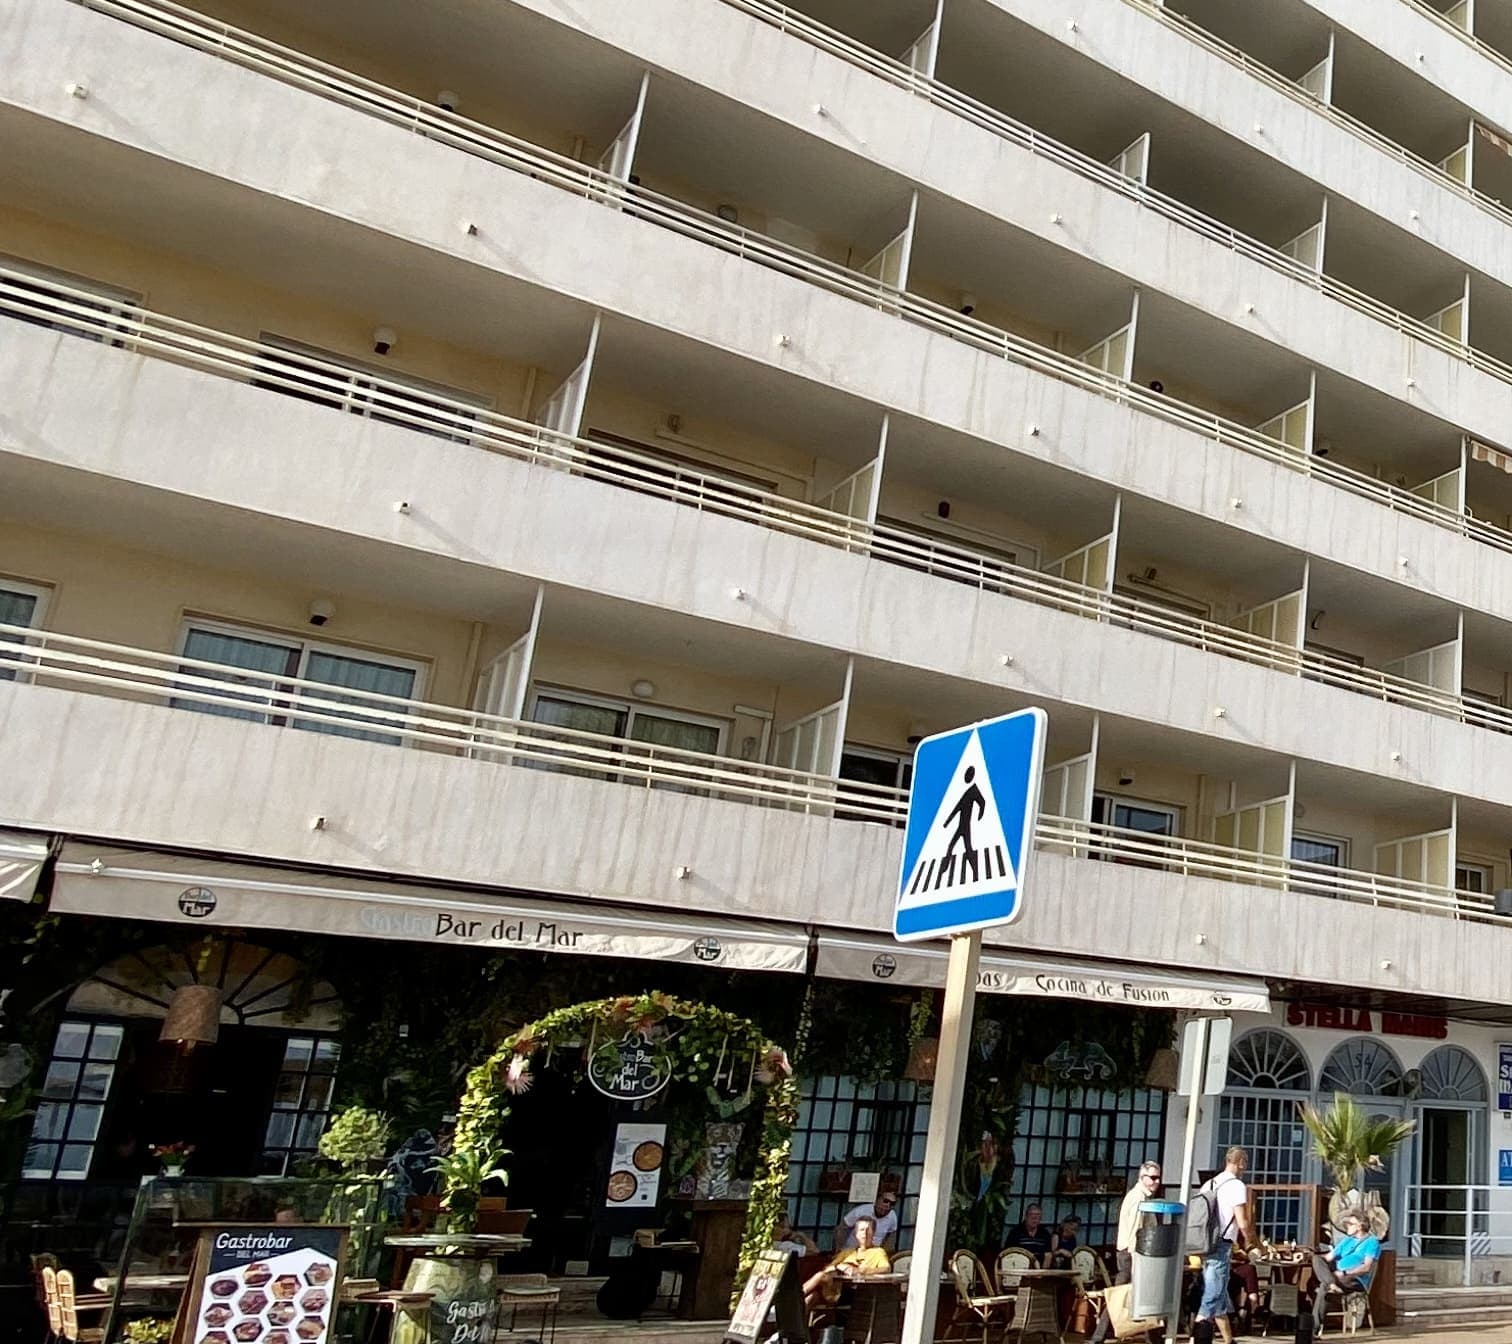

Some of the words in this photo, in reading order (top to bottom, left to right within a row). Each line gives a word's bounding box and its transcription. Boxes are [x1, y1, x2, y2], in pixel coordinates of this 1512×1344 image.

[491, 919, 524, 942] del
[535, 921, 584, 947] Mar
[1035, 974, 1087, 993] Cocina
[1096, 980, 1114, 997] de
[1287, 1003, 1373, 1033] STELLA
[622, 1062, 638, 1077] del
[608, 1073, 640, 1090] Mar
[216, 1232, 293, 1249] Gastrobar
